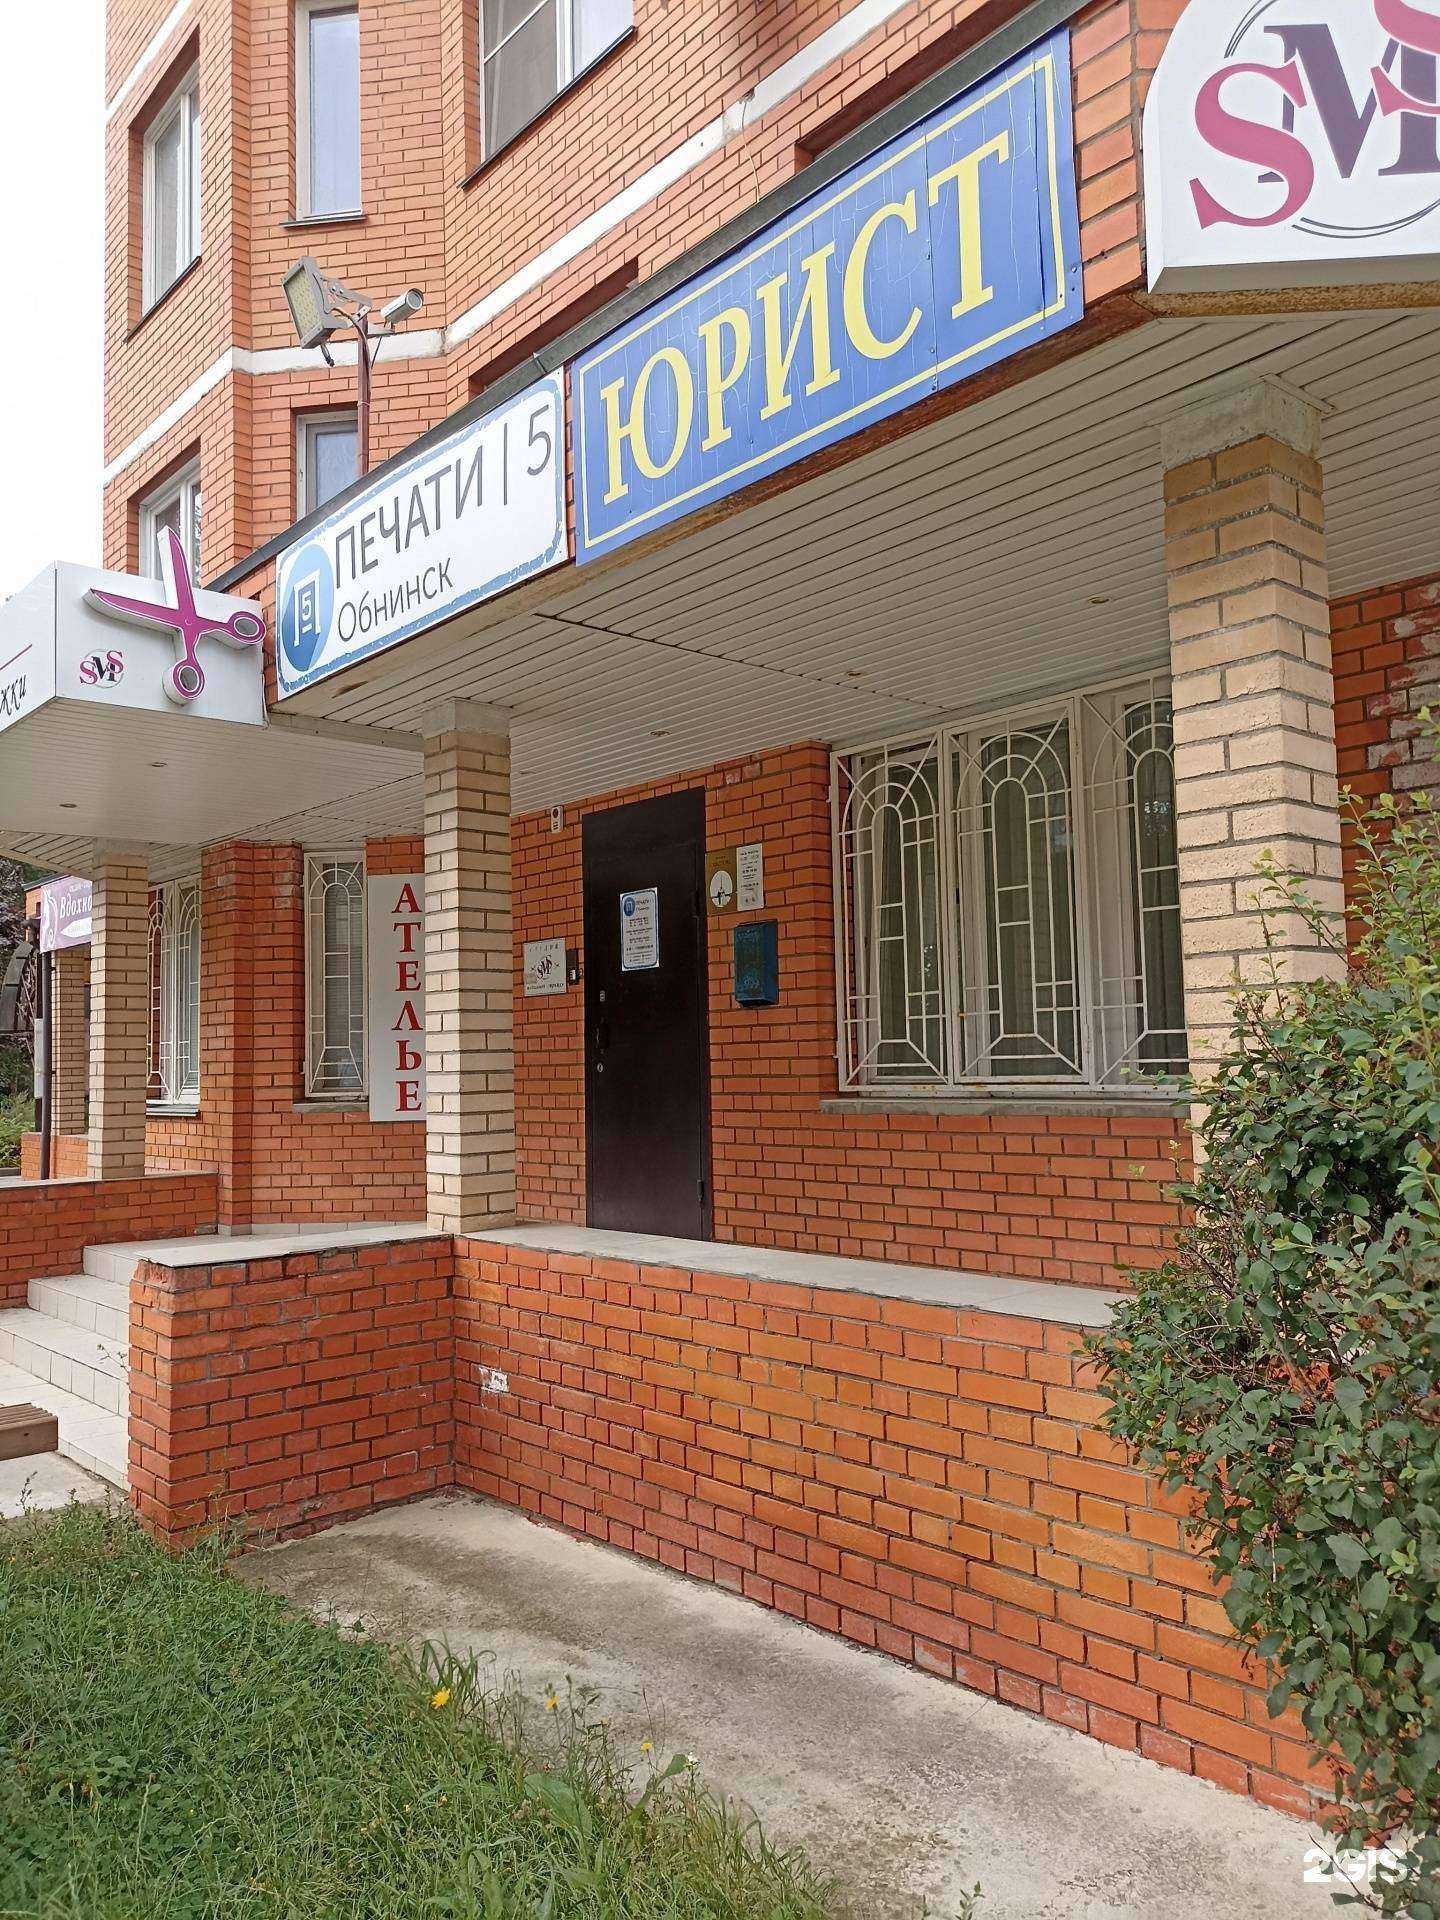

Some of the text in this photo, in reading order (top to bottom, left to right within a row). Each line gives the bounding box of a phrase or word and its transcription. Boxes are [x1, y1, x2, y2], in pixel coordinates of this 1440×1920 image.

[601, 131, 1009, 505] ЮРИСТ
[335, 445, 482, 589] ПЕЧАТИ
[527, 404, 552, 476] 5
[391, 883, 423, 1112] АТЕЛЬЕ
